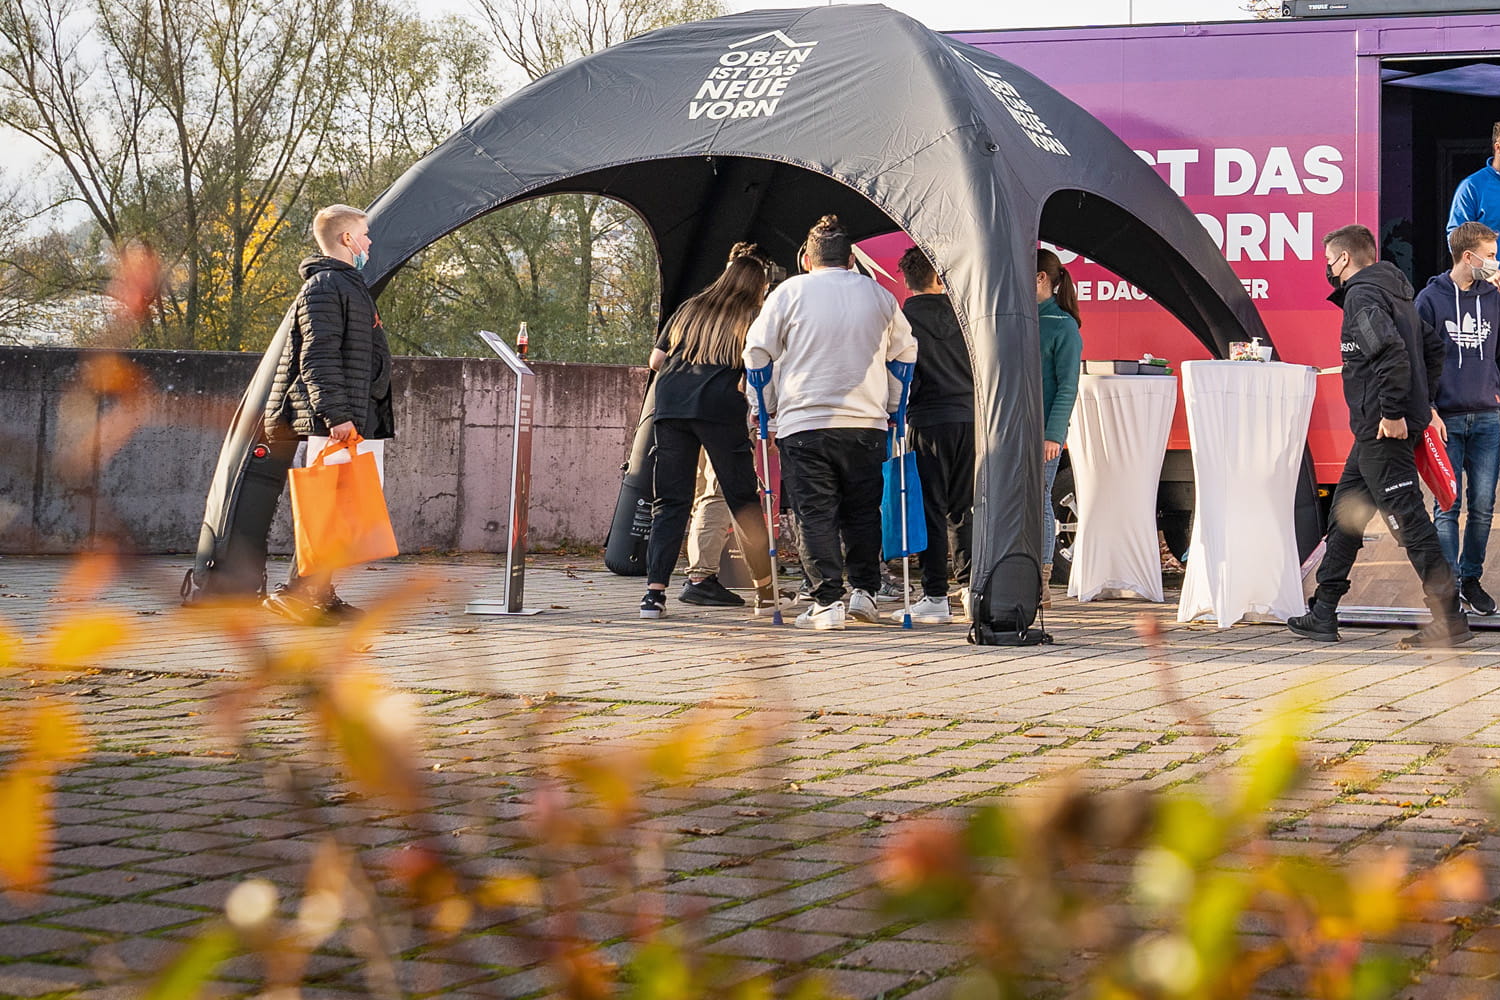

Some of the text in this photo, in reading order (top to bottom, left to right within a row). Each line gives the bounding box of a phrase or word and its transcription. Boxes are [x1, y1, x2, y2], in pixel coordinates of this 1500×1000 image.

[719, 48, 813, 67] OBEN
[708, 64, 801, 80] IST DAS
[694, 77, 792, 99] NEUE
[688, 98, 780, 120] VORN
[1020, 126, 1071, 157] VORN
[1213, 145, 1344, 196] DAS
